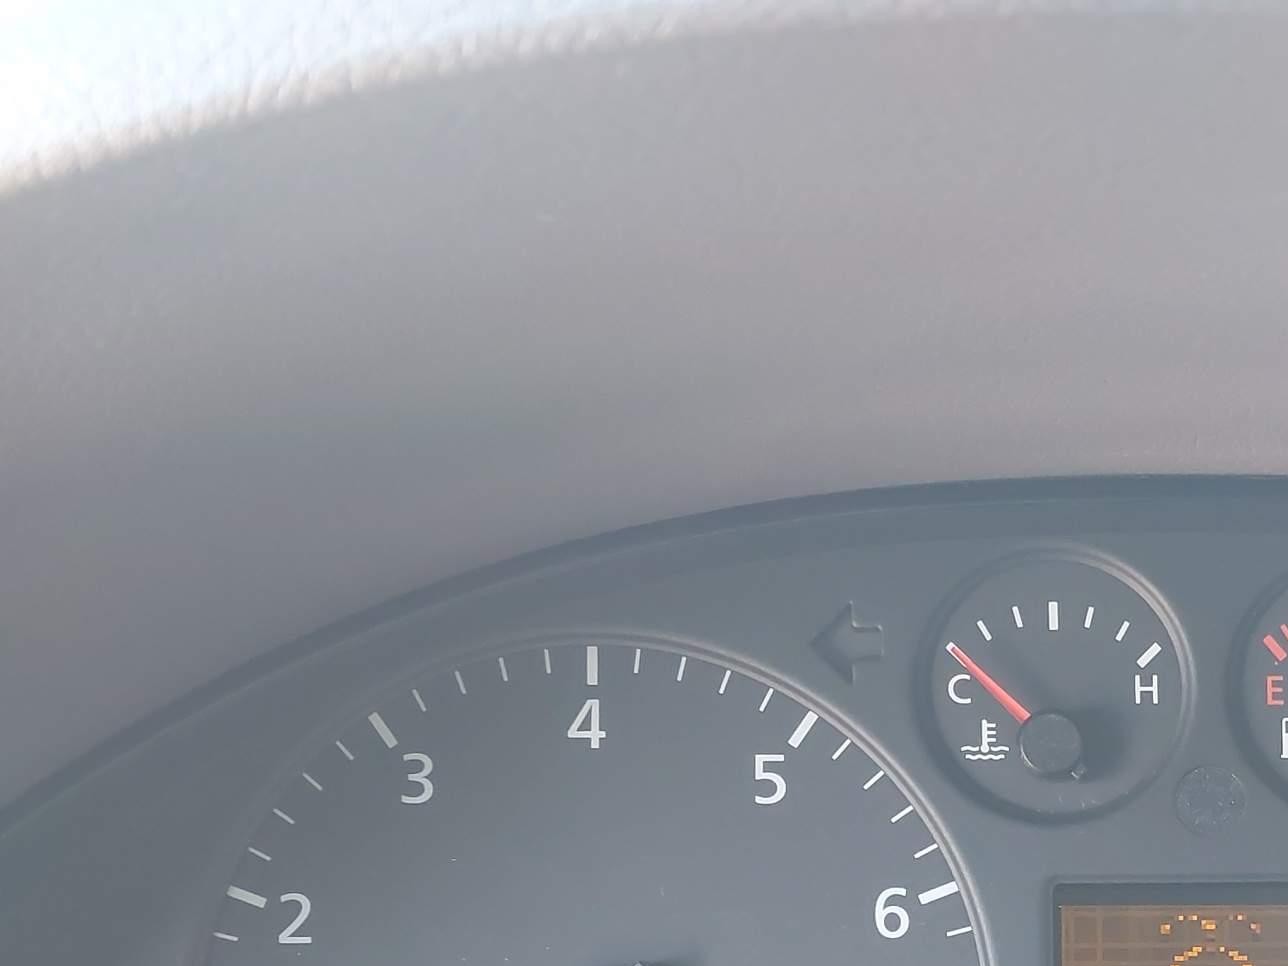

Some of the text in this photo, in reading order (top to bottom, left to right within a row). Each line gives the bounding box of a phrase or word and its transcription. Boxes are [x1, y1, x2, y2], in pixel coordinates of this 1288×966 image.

[946, 673, 972, 705] C
[1133, 674, 1160, 706] H
[1265, 674, 1286, 706] E
[566, 698, 607, 750] 4
[399, 752, 436, 806] 3
[752, 753, 788, 806] 5
[276, 892, 314, 946] 2
[872, 887, 911, 940] 6
